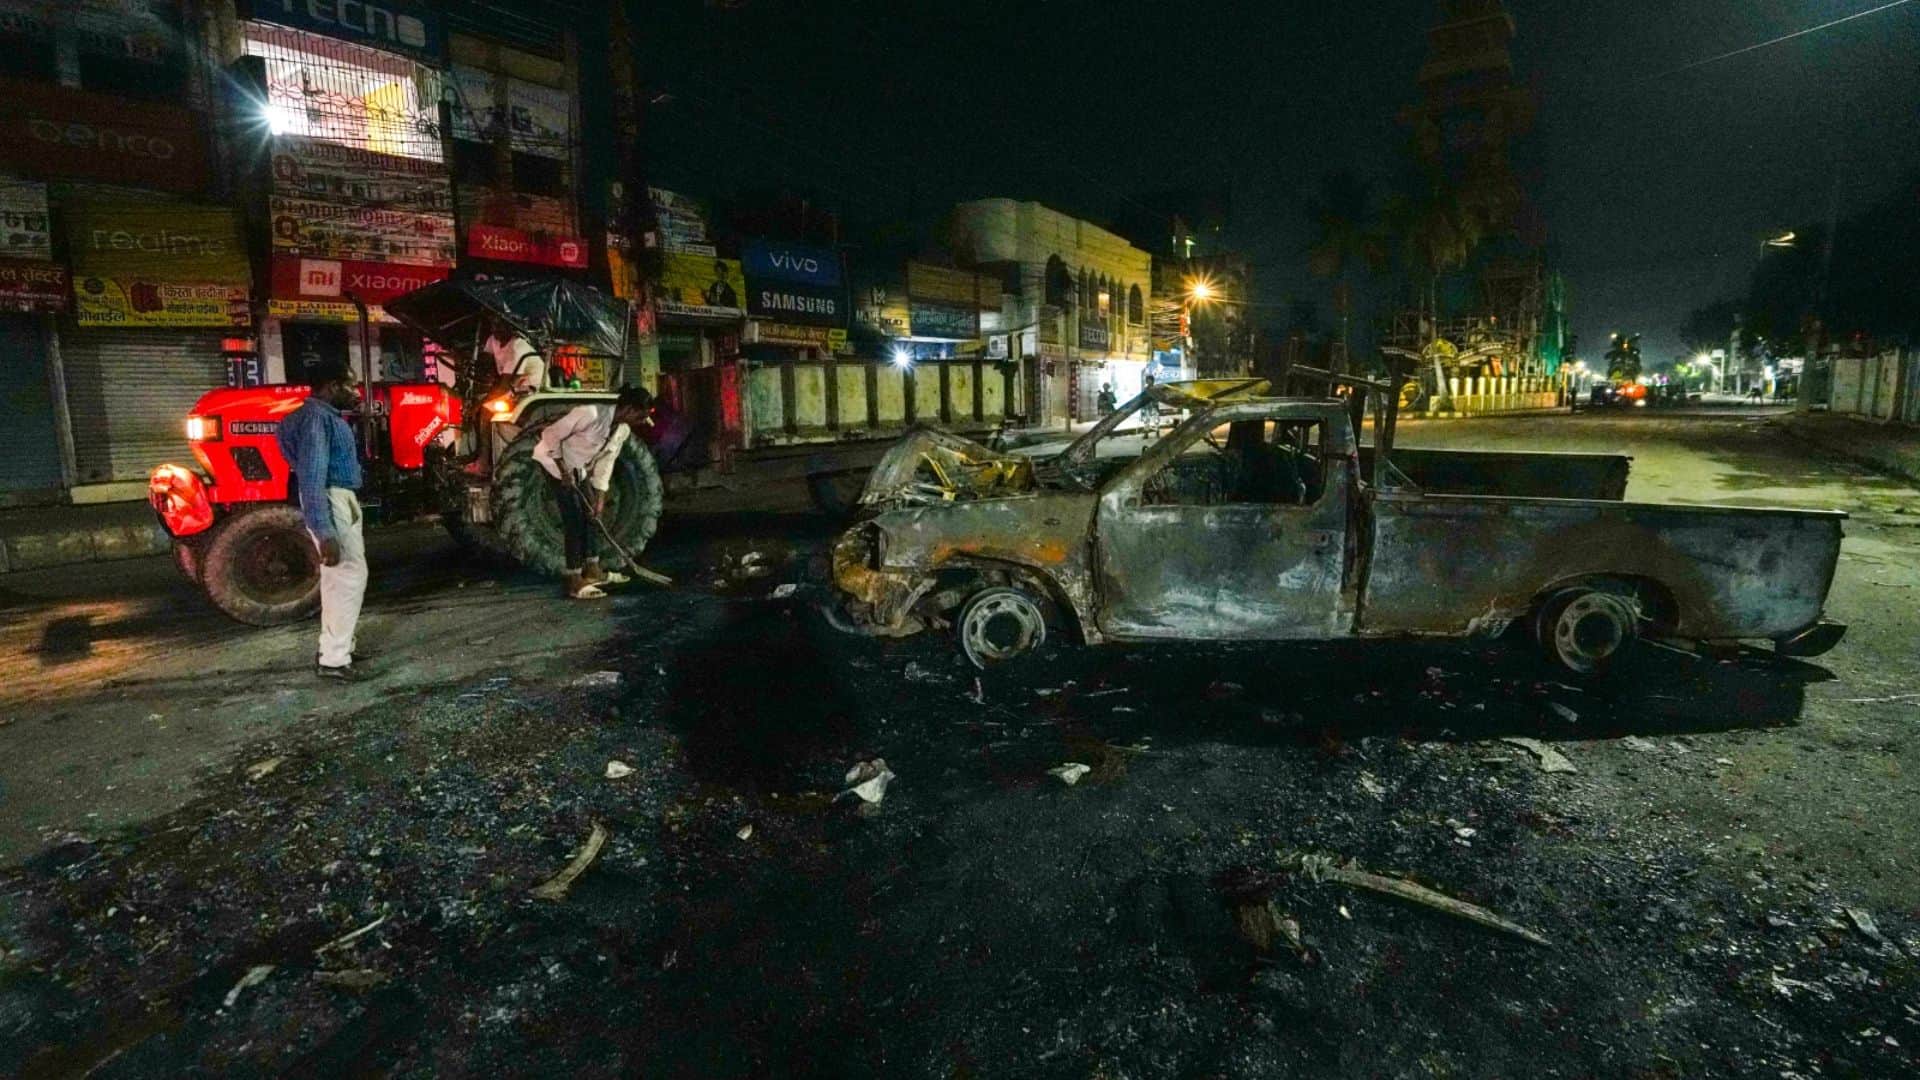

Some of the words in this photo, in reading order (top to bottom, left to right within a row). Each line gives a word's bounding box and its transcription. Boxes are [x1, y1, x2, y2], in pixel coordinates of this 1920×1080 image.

[92, 229, 226, 256] realme
[769, 250, 818, 272] vivo
[761, 290, 835, 315] SAMSUNG
